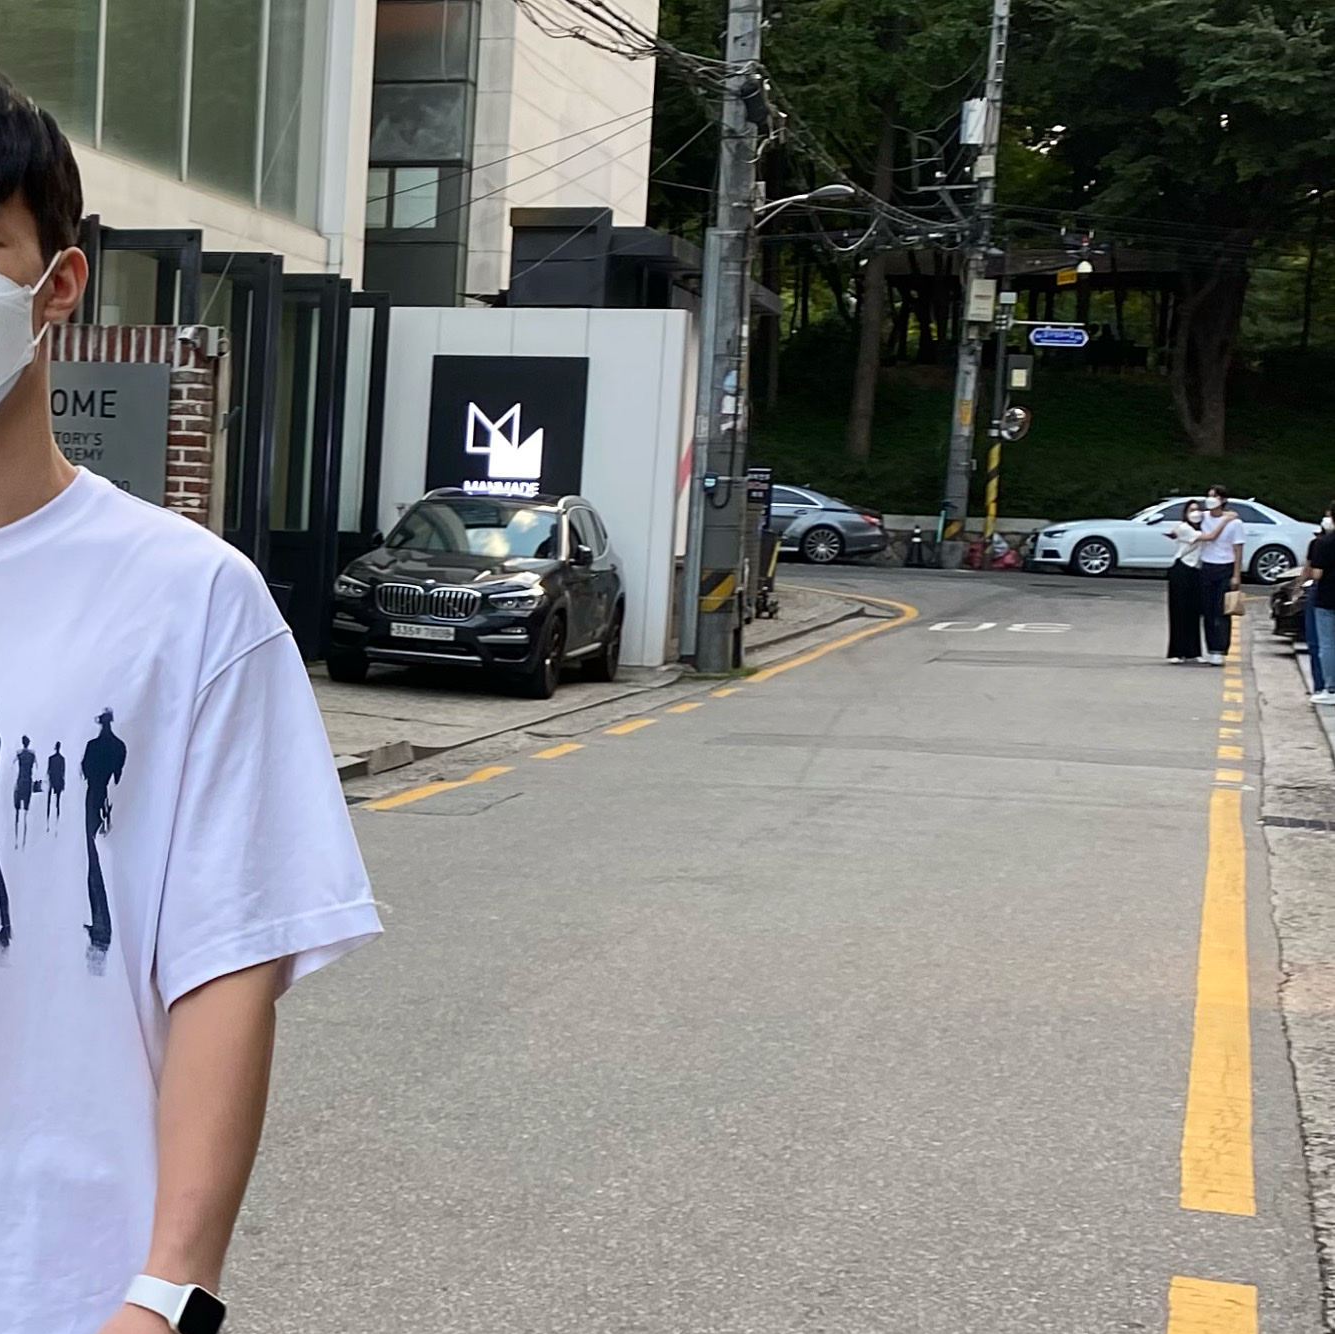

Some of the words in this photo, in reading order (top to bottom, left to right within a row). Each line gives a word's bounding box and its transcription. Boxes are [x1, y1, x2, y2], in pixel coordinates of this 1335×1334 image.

[51, 389, 117, 418] OME
[53, 431, 103, 446] TORY'S
[64, 447, 104, 461] DEMY
